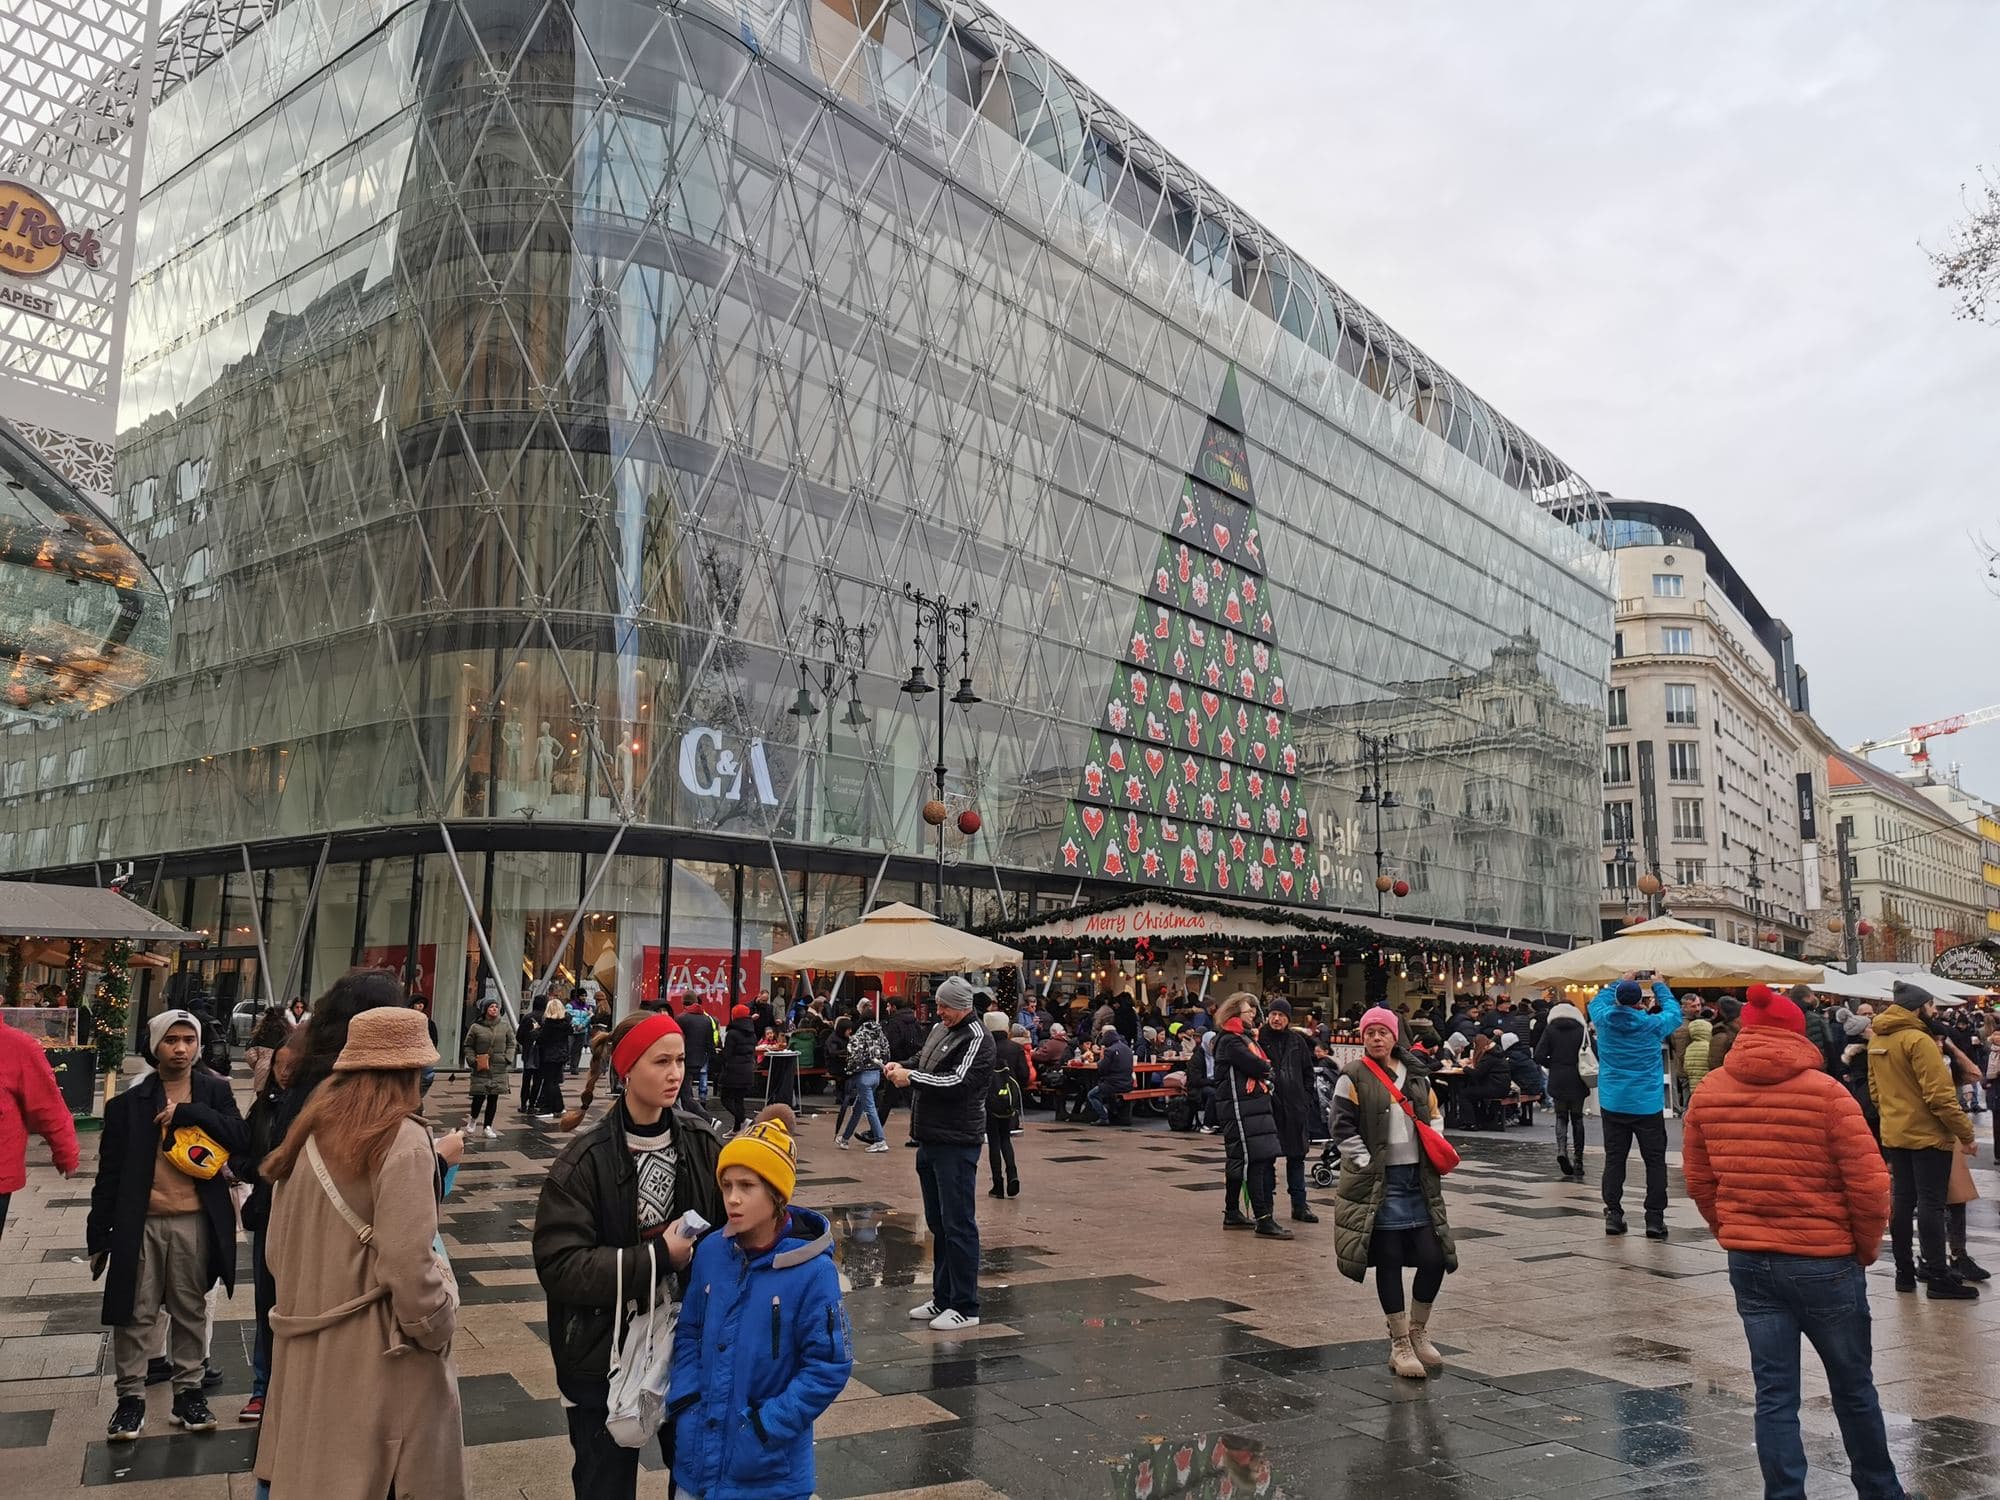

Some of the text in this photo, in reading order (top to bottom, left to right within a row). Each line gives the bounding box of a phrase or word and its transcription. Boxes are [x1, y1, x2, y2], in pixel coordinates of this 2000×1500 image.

[17, 207, 101, 268] Rock
[0, 287, 54, 314] APEST
[679, 726, 779, 806] C&A
[1319, 813, 1360, 857] Half
[1319, 854, 1363, 893] Price
[1085, 910, 1206, 933] Merry Christmas
